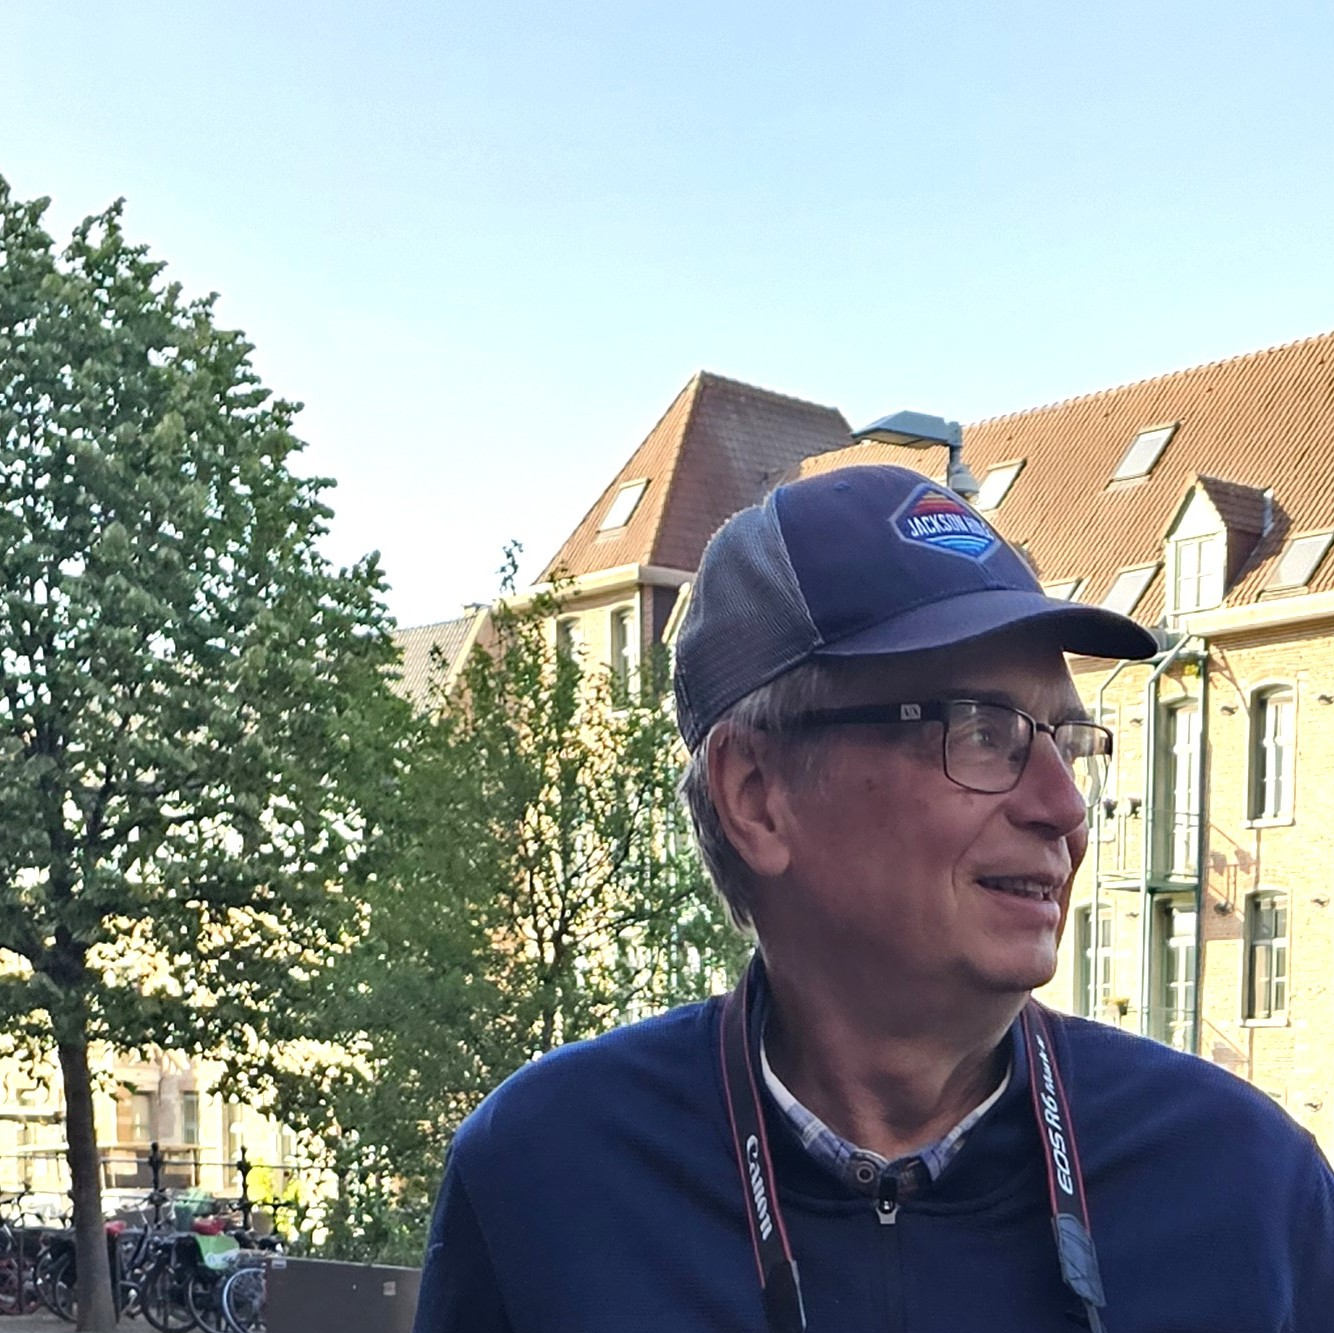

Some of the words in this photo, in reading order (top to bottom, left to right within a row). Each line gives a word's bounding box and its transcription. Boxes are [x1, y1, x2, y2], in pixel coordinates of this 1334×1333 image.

[907, 513, 969, 537] JACKSON
[1041, 1093, 1062, 1131] R6
[746, 1134, 773, 1240] Canon
[1050, 1128, 1074, 1195] EOS
